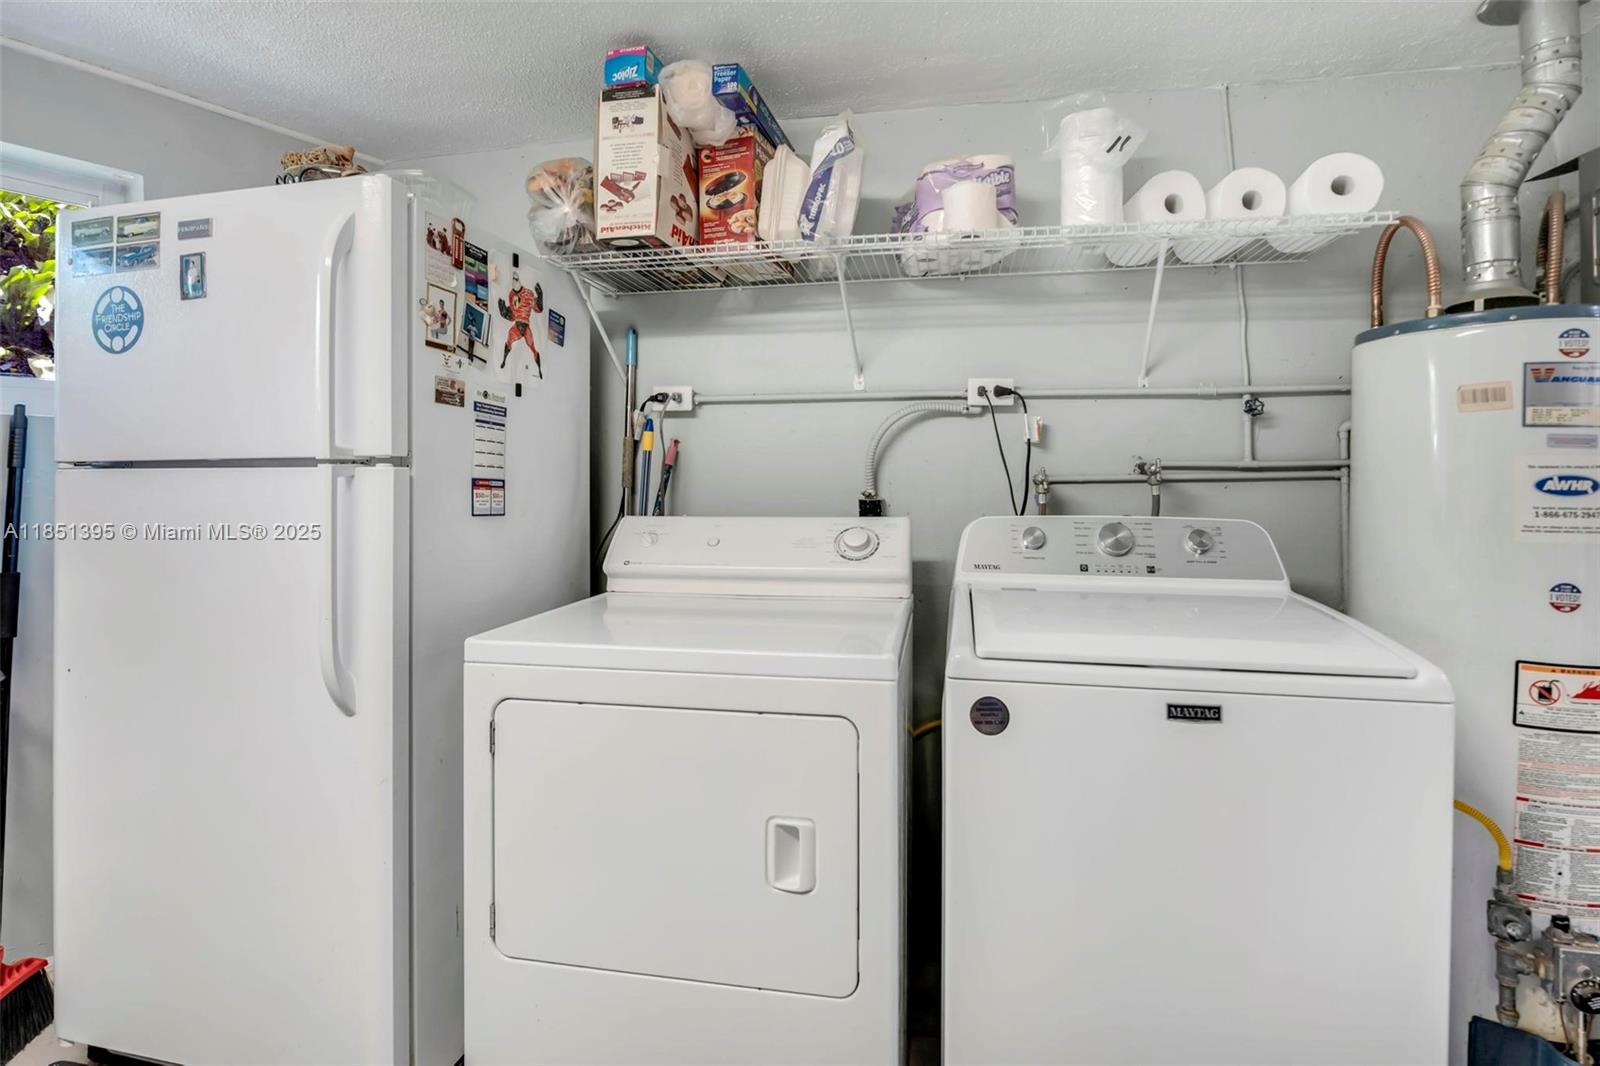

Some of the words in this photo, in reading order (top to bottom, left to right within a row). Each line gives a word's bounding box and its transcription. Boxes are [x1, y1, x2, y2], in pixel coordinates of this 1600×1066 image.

[612, 65, 638, 82] Ziploc
[714, 70, 737, 78] Freezer
[714, 76, 732, 84] Paper
[600, 223, 651, 234] KitchenAid
[112, 303, 125, 312] THE
[96, 311, 142, 324] FRIENDSHIP
[104, 321, 130, 333] CIRCLE
[1530, 368, 1600, 383] VANGUA
[1542, 476, 1594, 494] AWHR
[973, 563, 1000, 571] MAYTAG
[1169, 706, 1219, 718] MAYTAG
